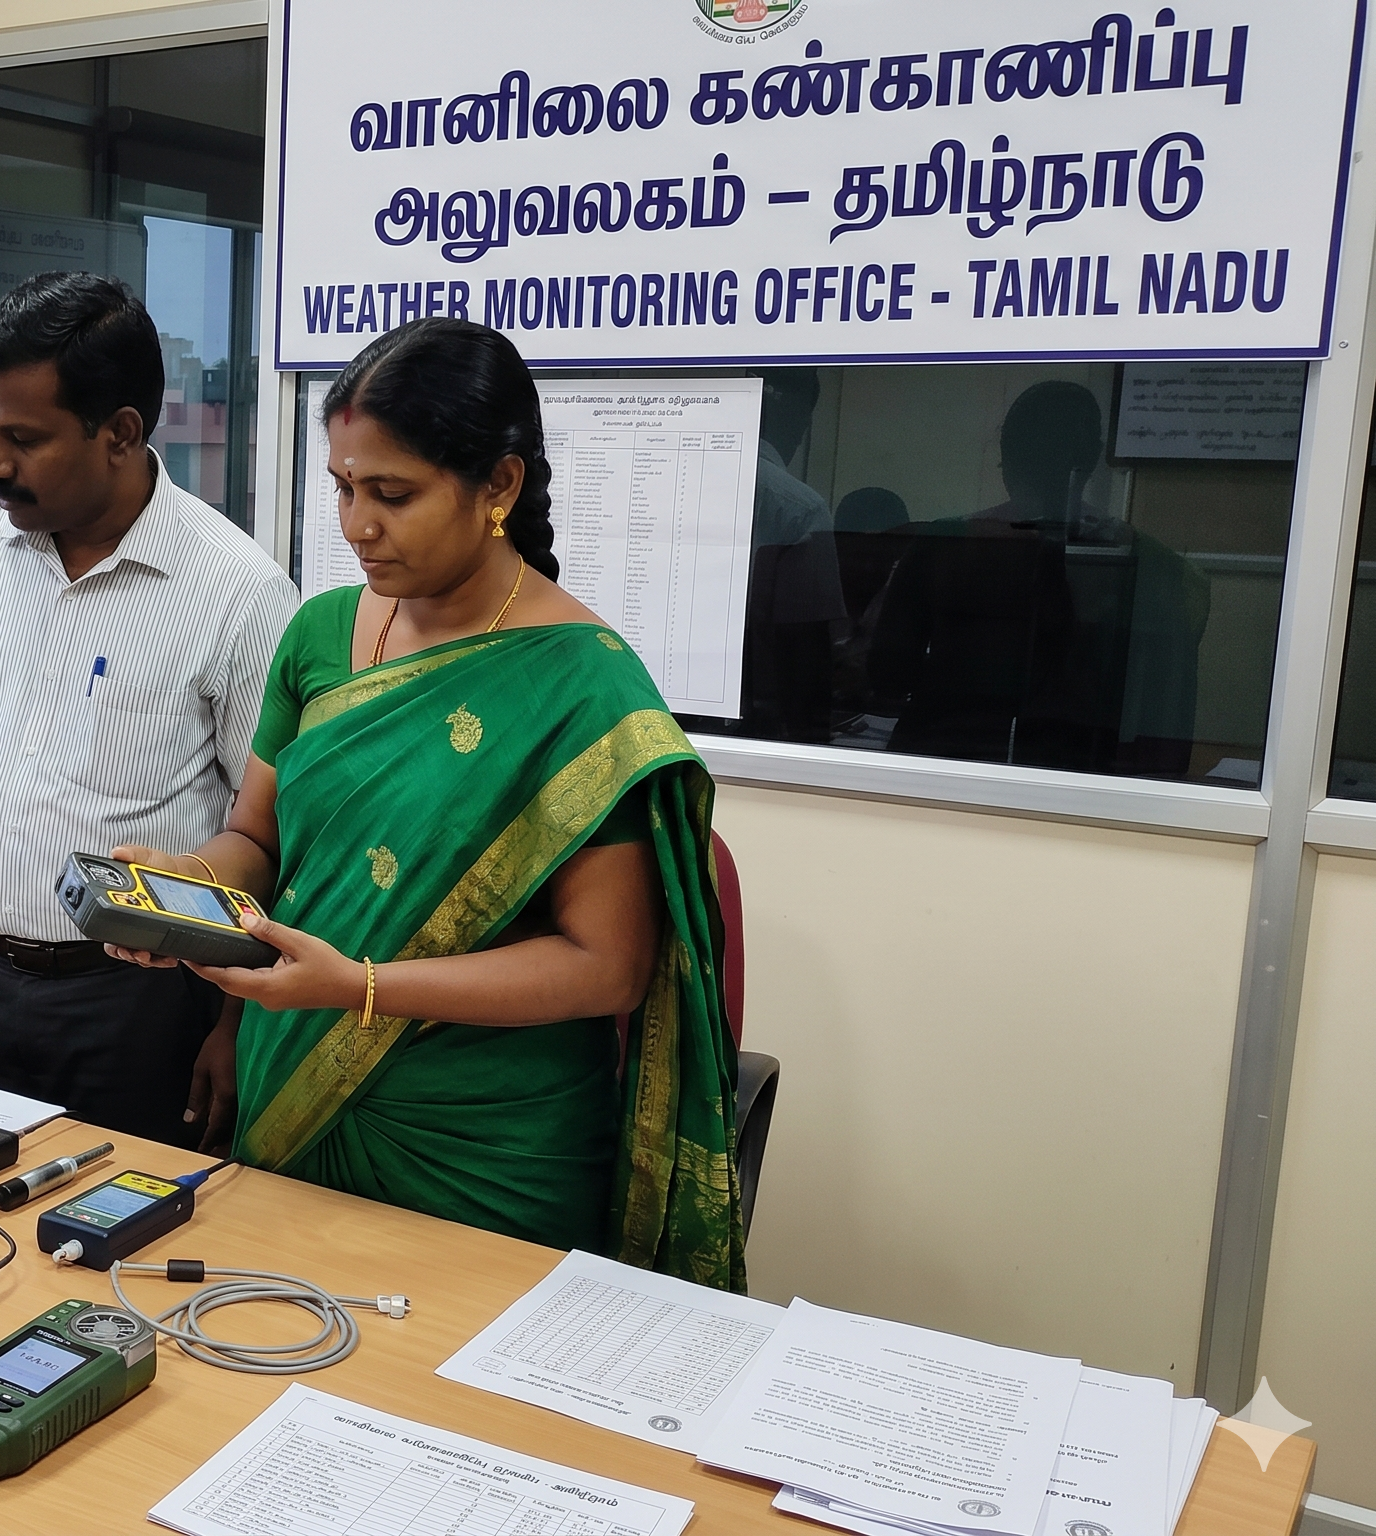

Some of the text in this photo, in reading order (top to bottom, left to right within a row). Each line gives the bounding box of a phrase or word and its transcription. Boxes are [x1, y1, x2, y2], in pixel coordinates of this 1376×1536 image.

[351, 7, 1249, 153] வானிலை கண்காணிப்பு
[374, 153, 744, 264] அலுவலகம்
[829, 131, 1205, 245] தமிழ்நாடு
[303, 280, 470, 334] WEATHER
[484, 270, 737, 331] MONITORING
[754, 263, 915, 325] OFFICE
[968, 255, 1119, 319] TAMIL
[1138, 248, 1290, 315] NADU
